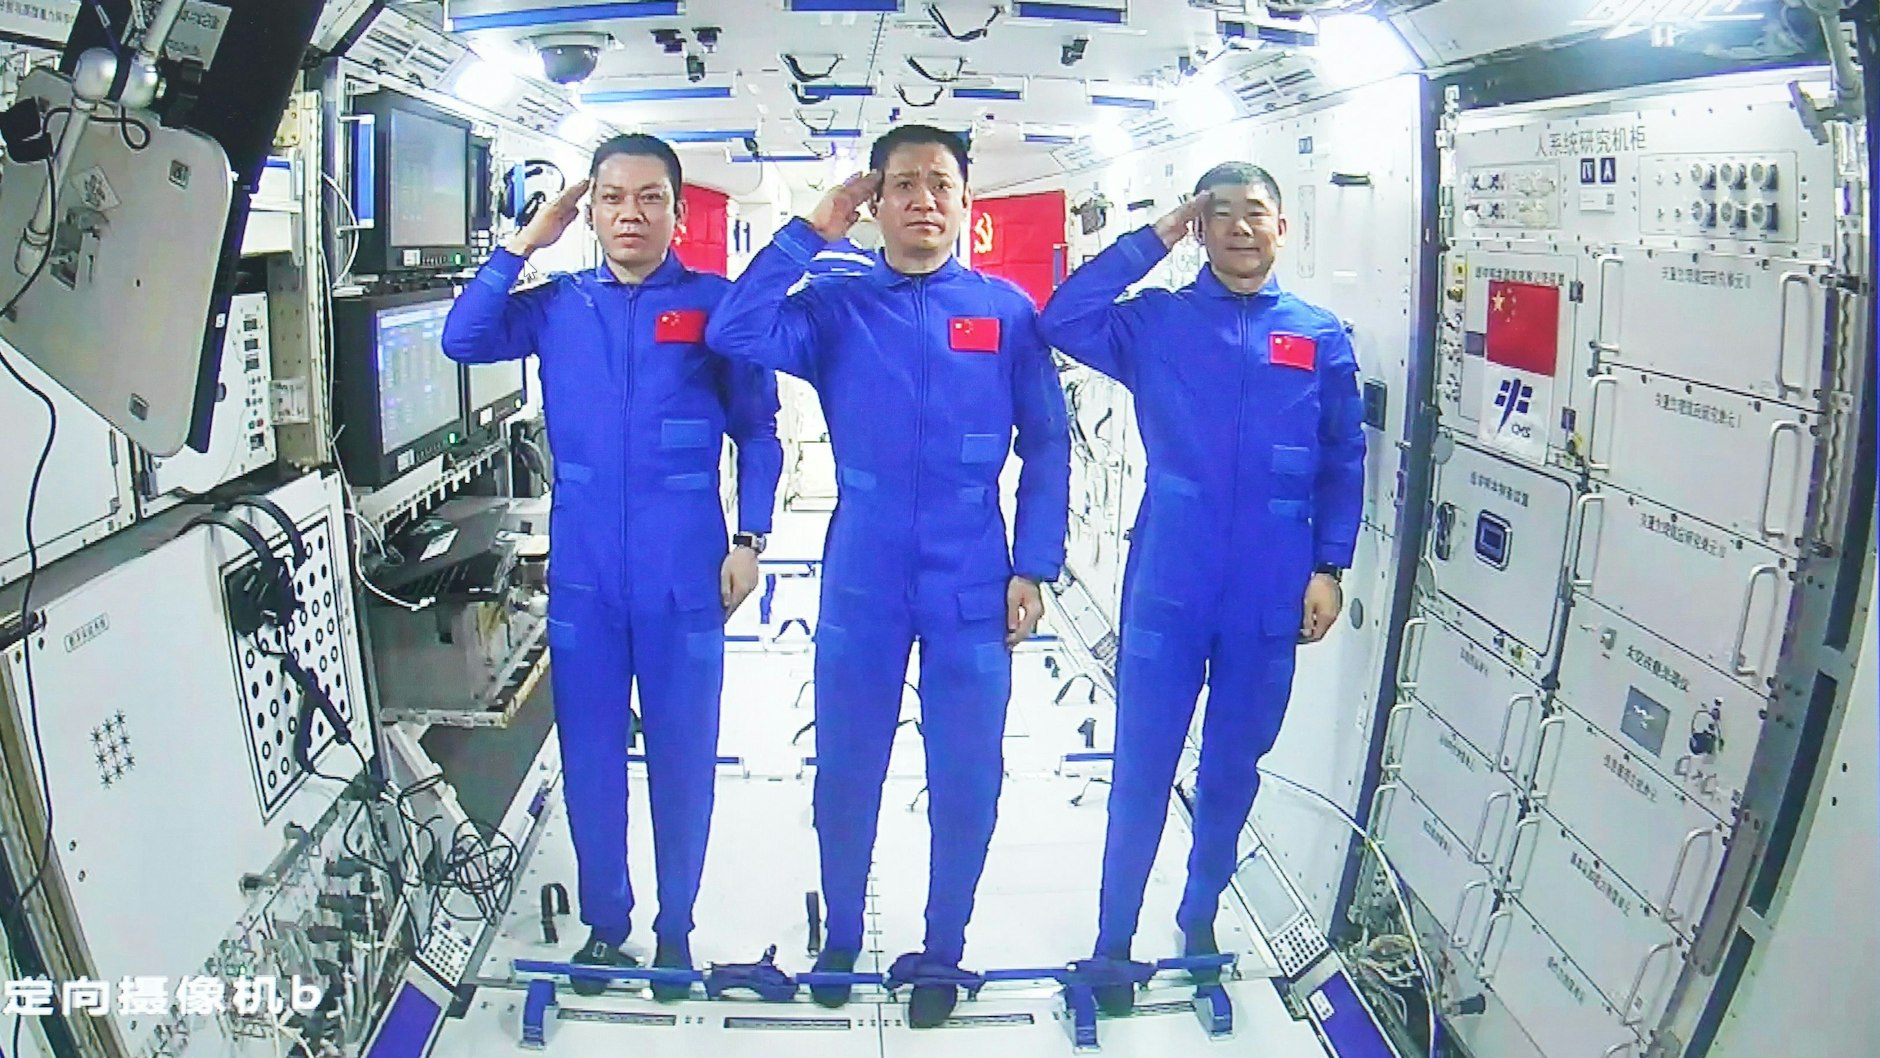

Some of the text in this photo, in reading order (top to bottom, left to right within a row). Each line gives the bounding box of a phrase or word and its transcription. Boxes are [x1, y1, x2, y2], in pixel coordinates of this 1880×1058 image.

[1536, 126, 1647, 156] 人系统研究机柜
